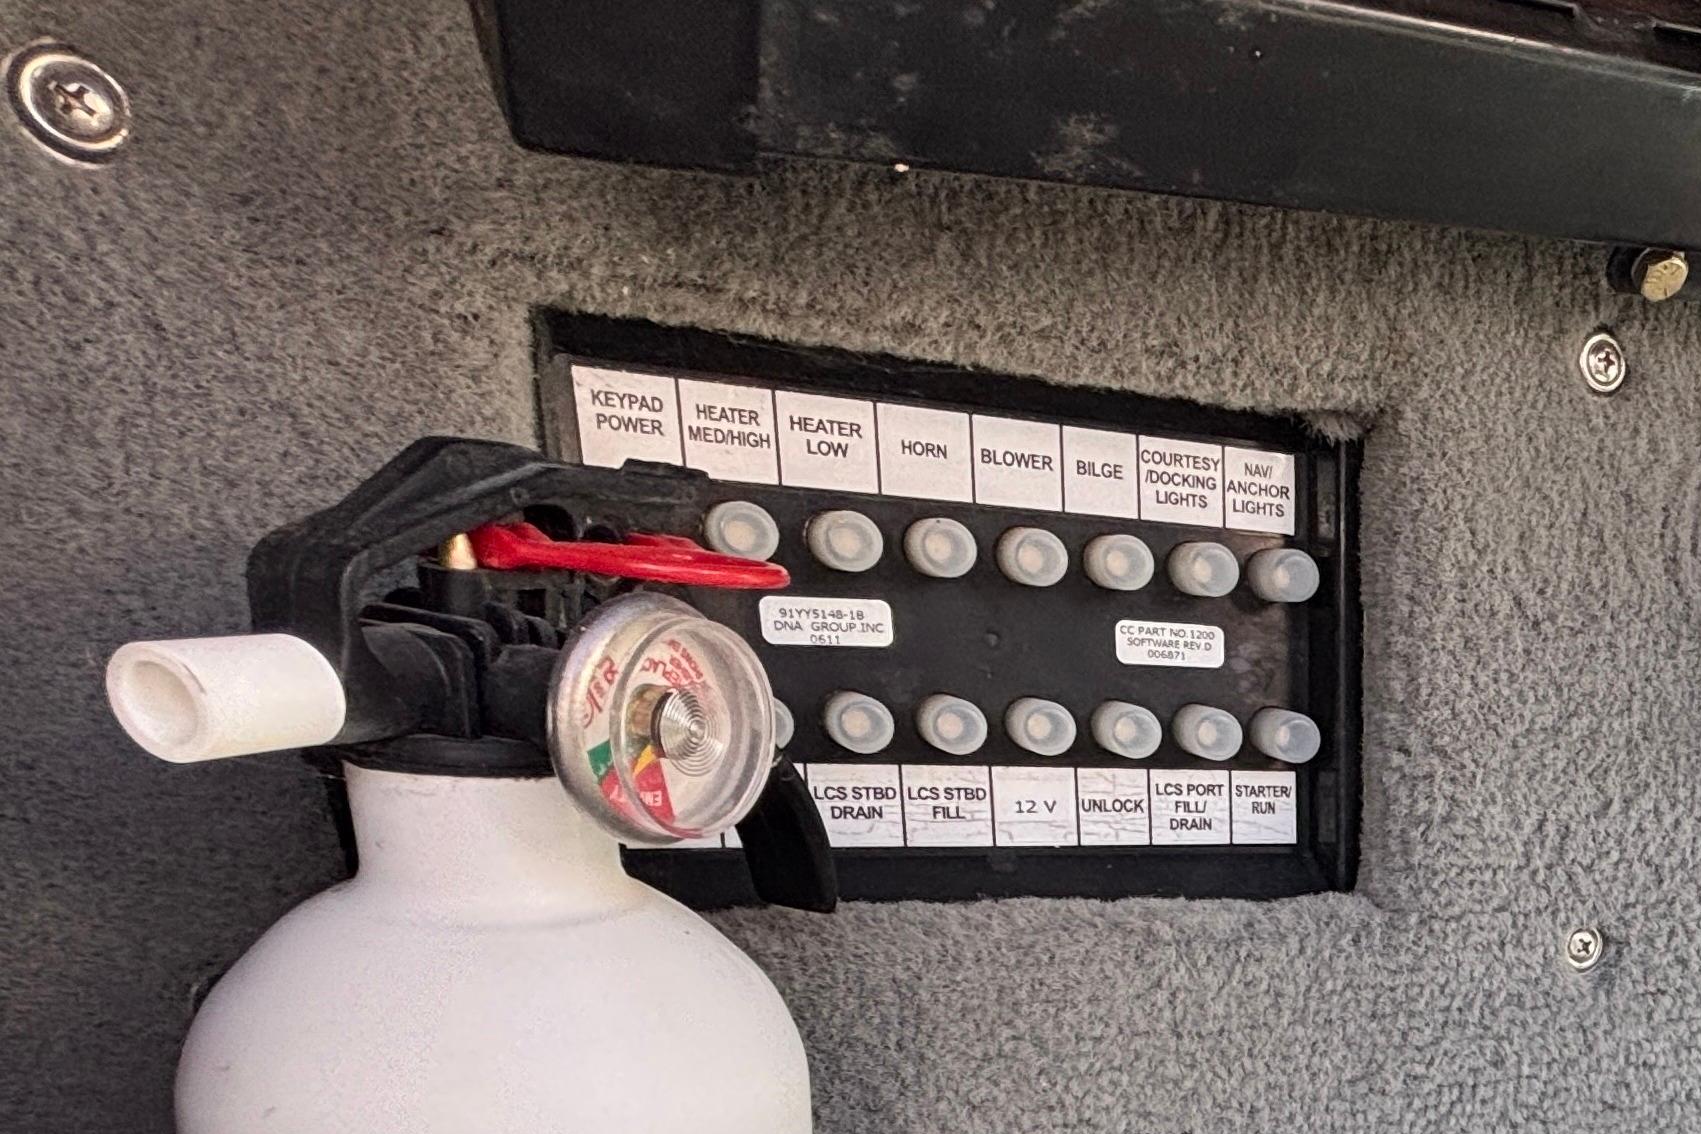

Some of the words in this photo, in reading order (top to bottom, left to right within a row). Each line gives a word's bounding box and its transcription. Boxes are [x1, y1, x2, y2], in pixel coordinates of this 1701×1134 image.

[590, 389, 664, 413] KEYPAD
[695, 403, 760, 427] HEATER
[595, 413, 664, 436] POWER
[789, 415, 862, 439] HEATER
[687, 425, 771, 449] MED/HIGH
[806, 439, 849, 458] LOW
[901, 439, 948, 459] HORN
[980, 448, 1054, 471] BLOWER
[1140, 449, 1220, 472] COURTESY
[1076, 459, 1124, 480] BILGE
[1244, 462, 1273, 480] NAV/
[1145, 469, 1217, 491] /DOCKING
[1226, 479, 1290, 500] ANCHOR
[1155, 490, 1208, 509] LIGHTS
[1232, 498, 1285, 518] LIGHTS
[774, 620, 803, 631] DNA
[811, 621, 856, 633] GROUP
[1119, 625, 1135, 635] CC
[1138, 626, 1167, 637] PART
[810, 634, 841, 645] 0611
[1127, 637, 1180, 650] SOFTWARE
[1183, 640, 1201, 651] REV
[813, 786, 847, 801] LCS
[852, 786, 897, 801] STBD
[907, 786, 940, 801] LCS
[944, 786, 987, 801] STBD
[1155, 783, 1183, 796] LCS
[1187, 784, 1224, 797] PORT
[1235, 785, 1292, 798] STARTER/
[830, 805, 883, 820] DRAIN
[932, 805, 966, 820] FILL
[1015, 800, 1037, 814] 12
[1043, 800, 1057, 813] V
[1081, 799, 1145, 813] UNLOCK
[1174, 800, 1207, 814] FILL/
[1251, 801, 1276, 815] RUN
[1169, 818, 1212, 831] DRAIN
